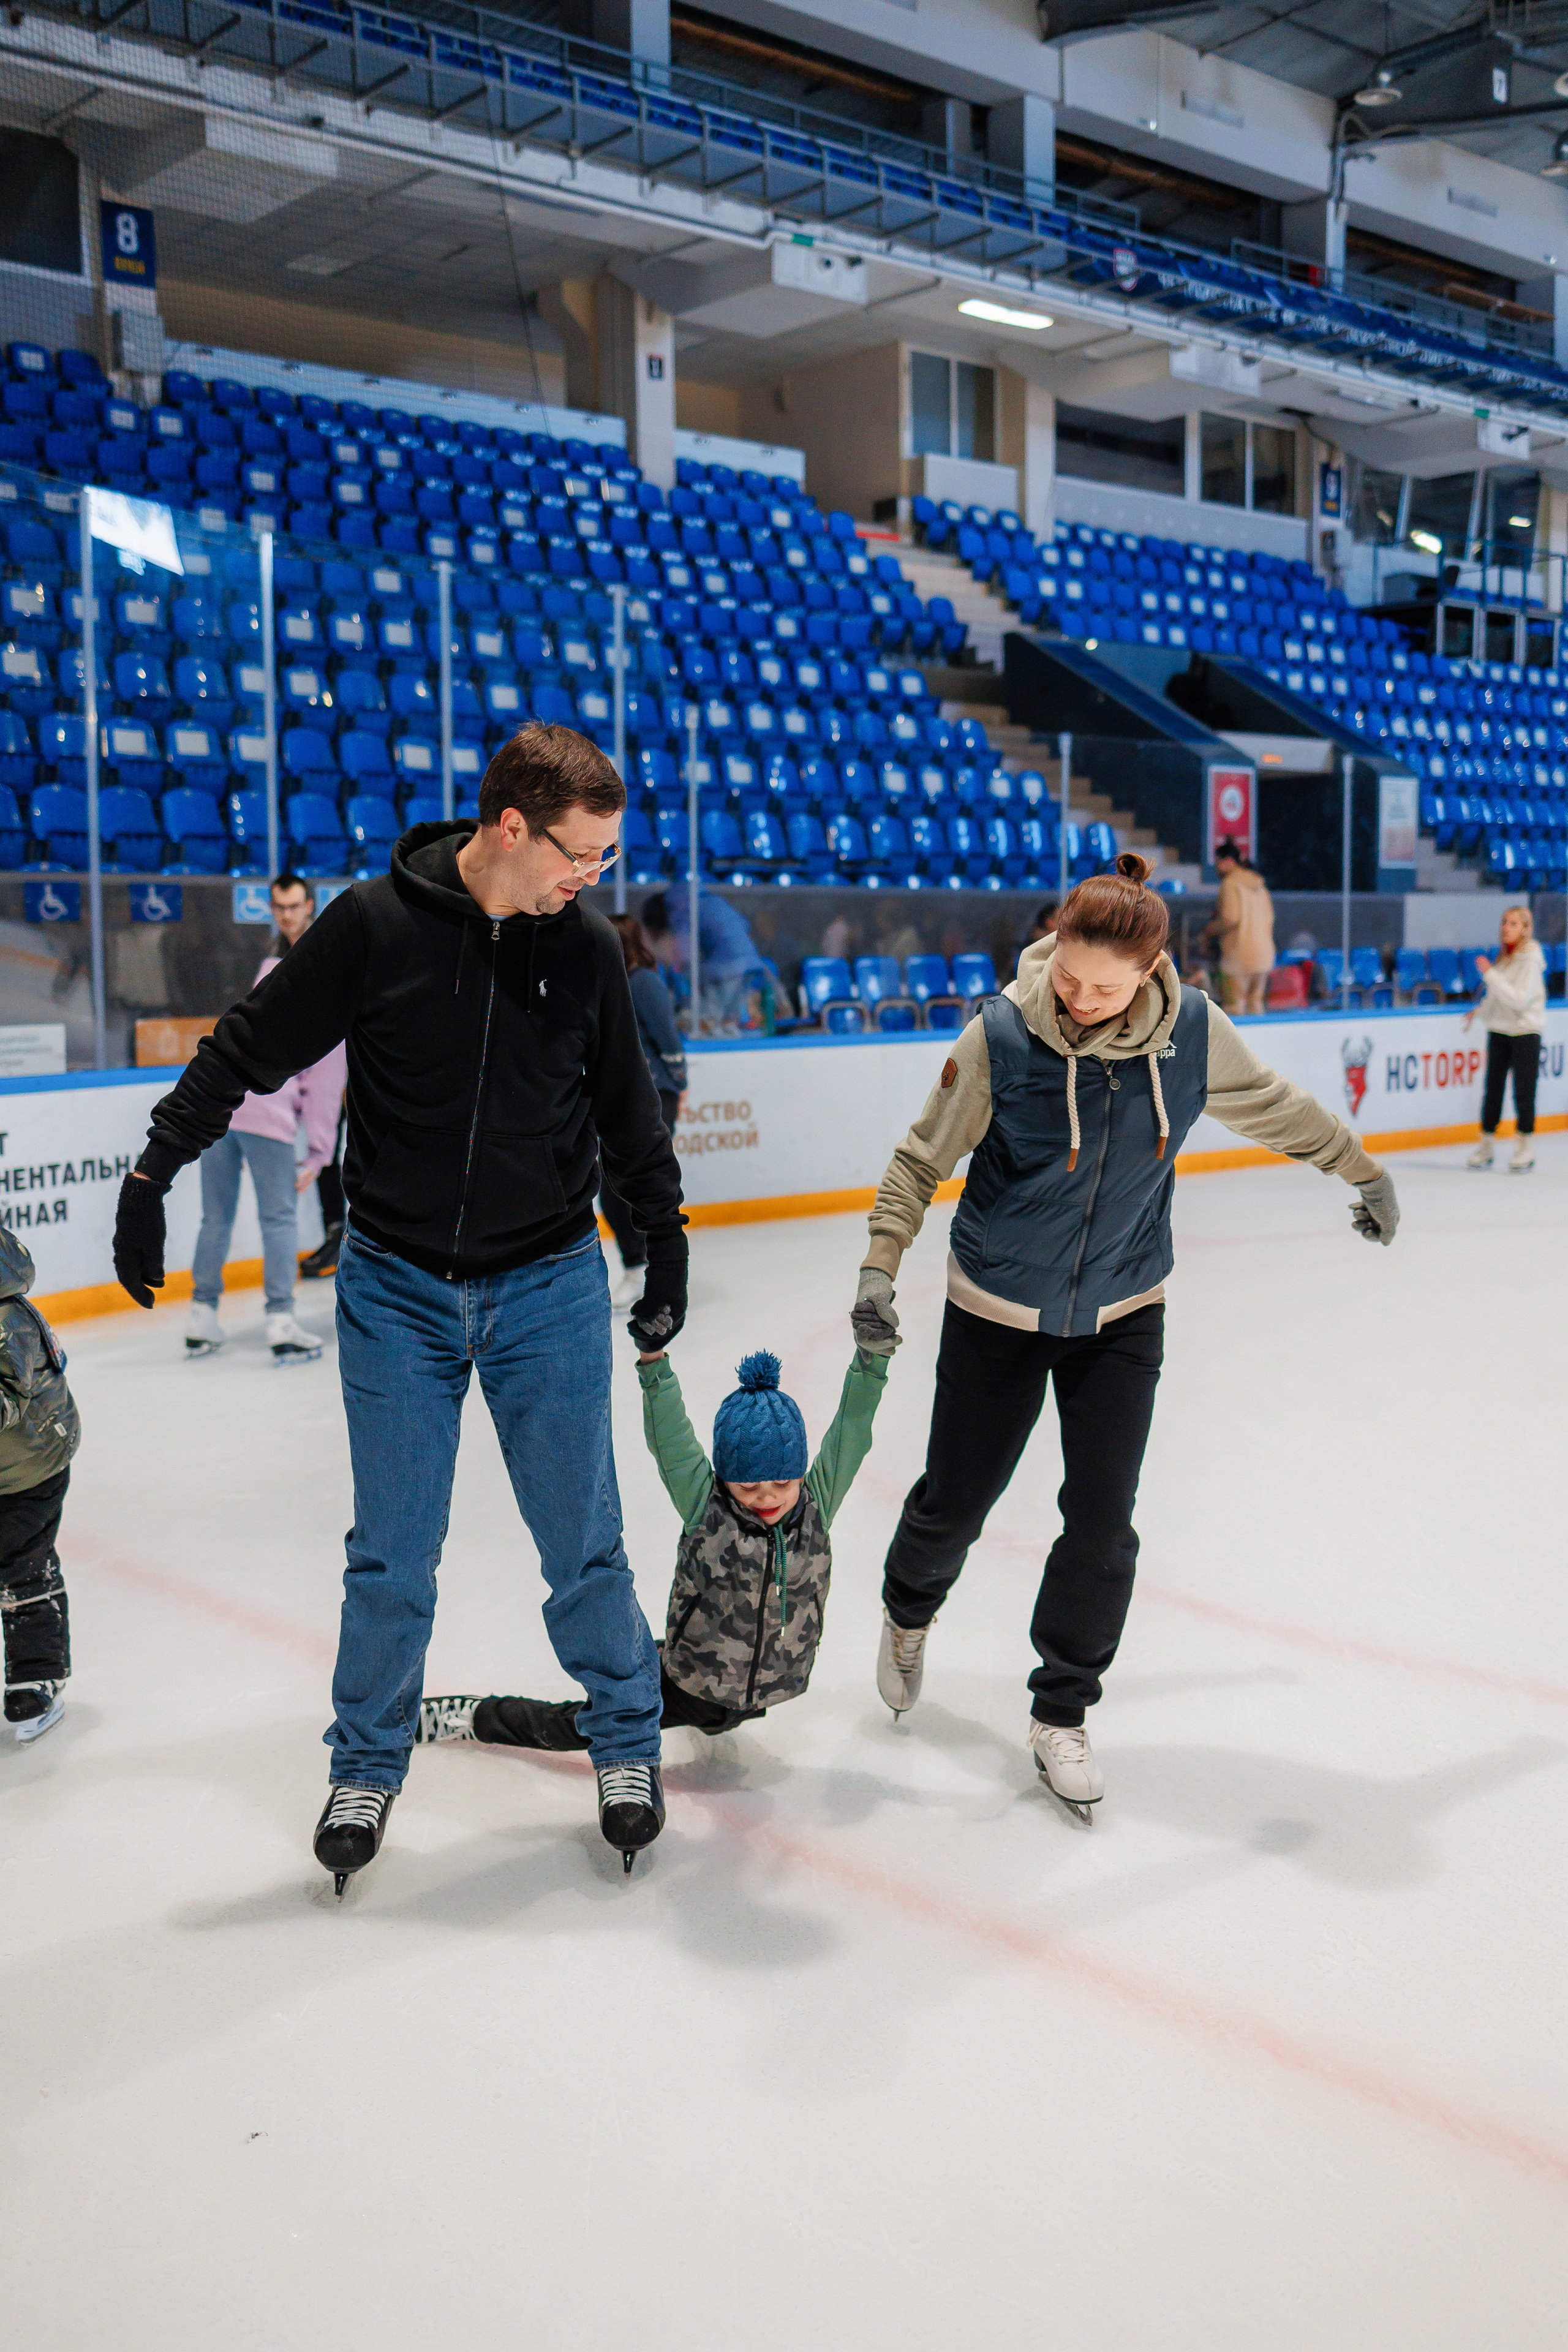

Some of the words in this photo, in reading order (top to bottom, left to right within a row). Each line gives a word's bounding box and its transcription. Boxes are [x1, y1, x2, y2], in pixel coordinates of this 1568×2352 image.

[115, 212, 139, 254] 8
[1157, 1049, 1175, 1058] appa
[1386, 1042, 1564, 1093] HCTORPRU
[679, 1101, 752, 1123] ЬСТВО
[674, 1122, 758, 1155] ОДСКОЙ
[0, 1154, 142, 1192] НЕНТАЛЬН
